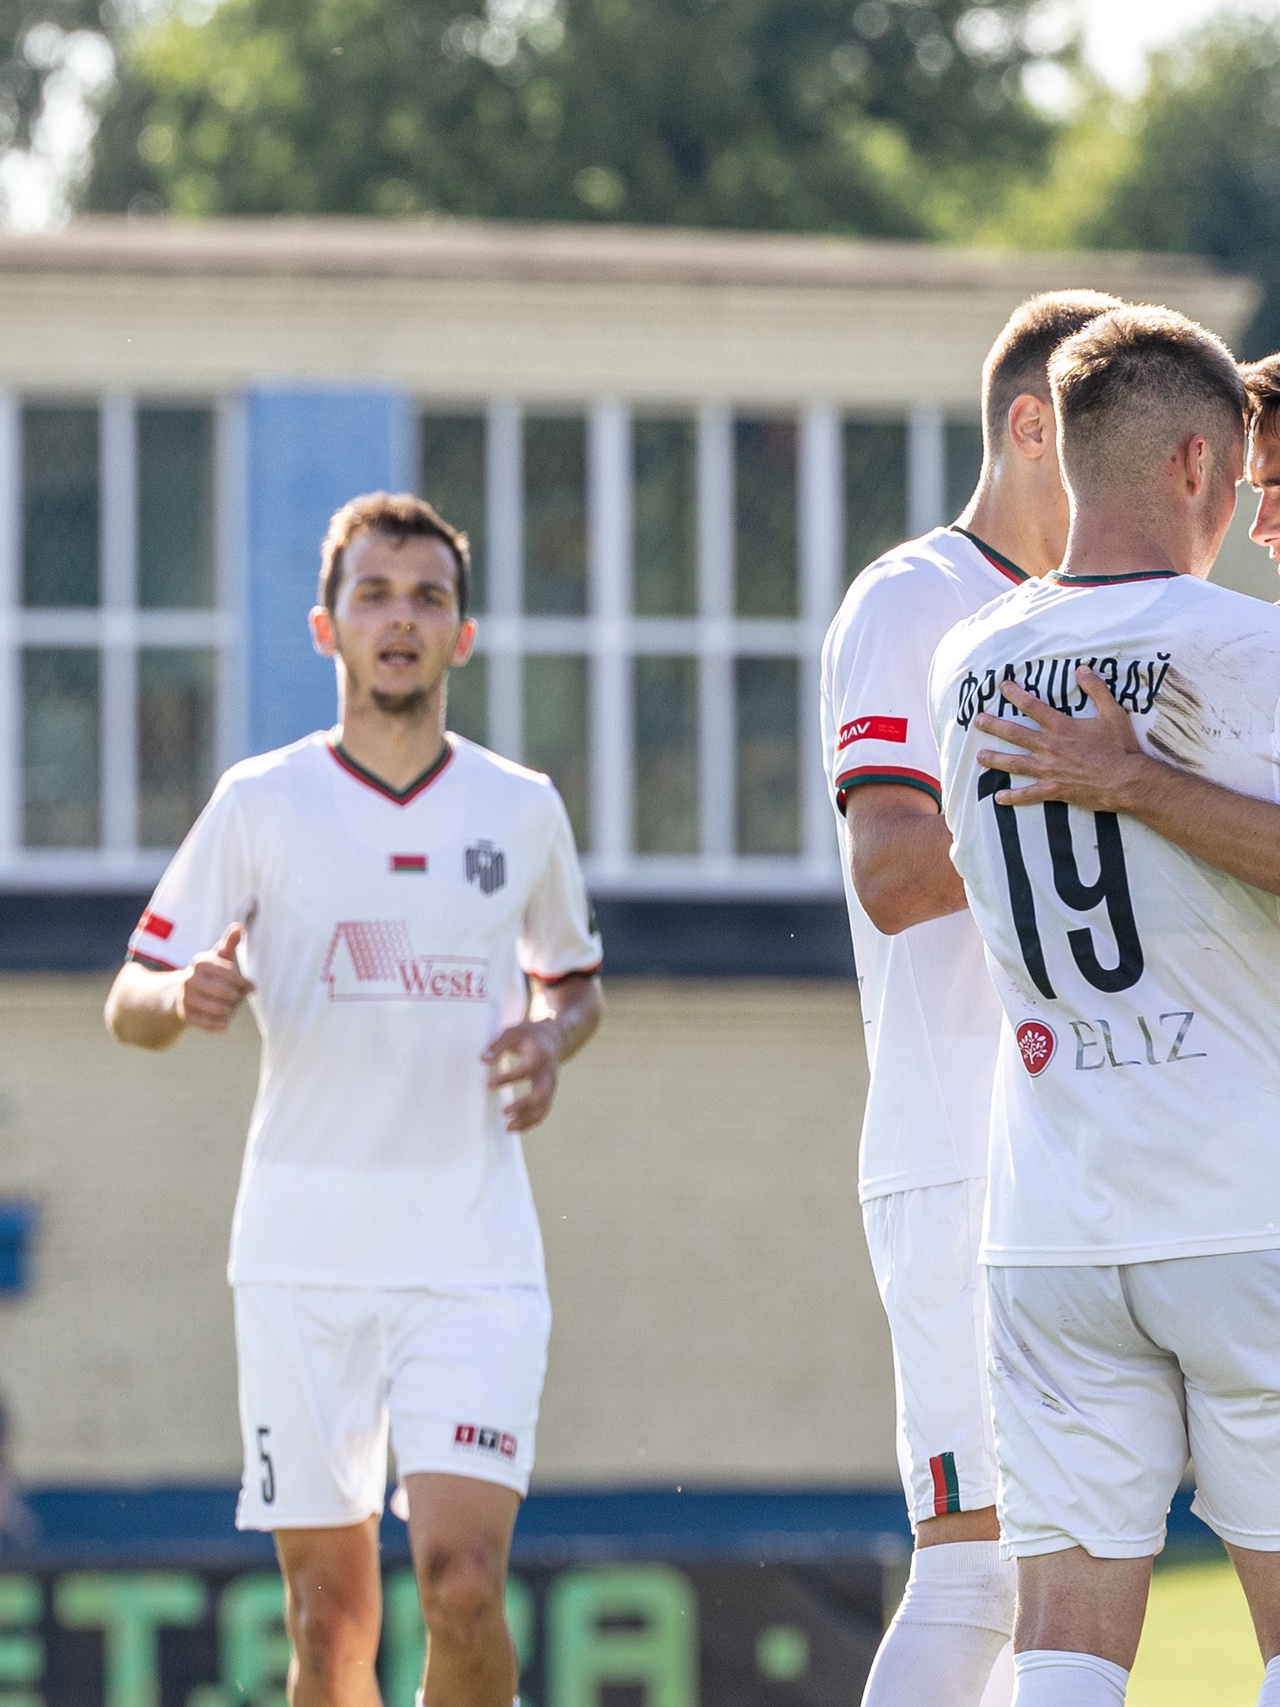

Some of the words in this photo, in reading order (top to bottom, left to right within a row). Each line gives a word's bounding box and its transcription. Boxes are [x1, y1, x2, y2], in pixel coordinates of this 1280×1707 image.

[978, 766, 1145, 999] 19
[1068, 1011, 1207, 1070] ELIZ
[257, 1427, 275, 1505] 5
